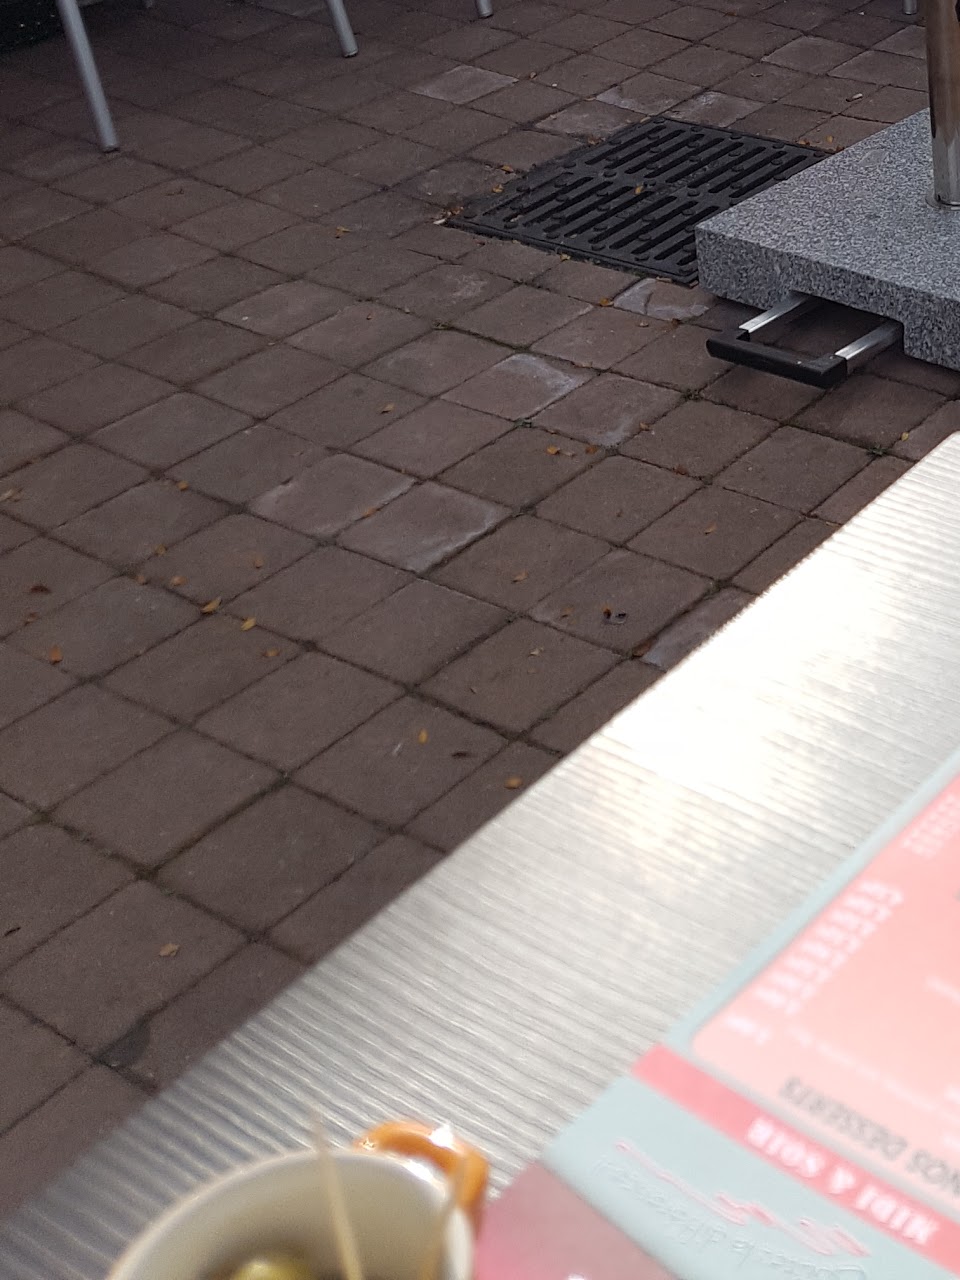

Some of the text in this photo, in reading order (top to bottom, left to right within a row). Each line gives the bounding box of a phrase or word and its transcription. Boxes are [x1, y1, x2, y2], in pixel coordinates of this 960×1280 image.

[745, 1118, 826, 1178] SOIR
[778, 1076, 909, 1163] DESSERTS
[855, 1182, 939, 1245] MIDI
